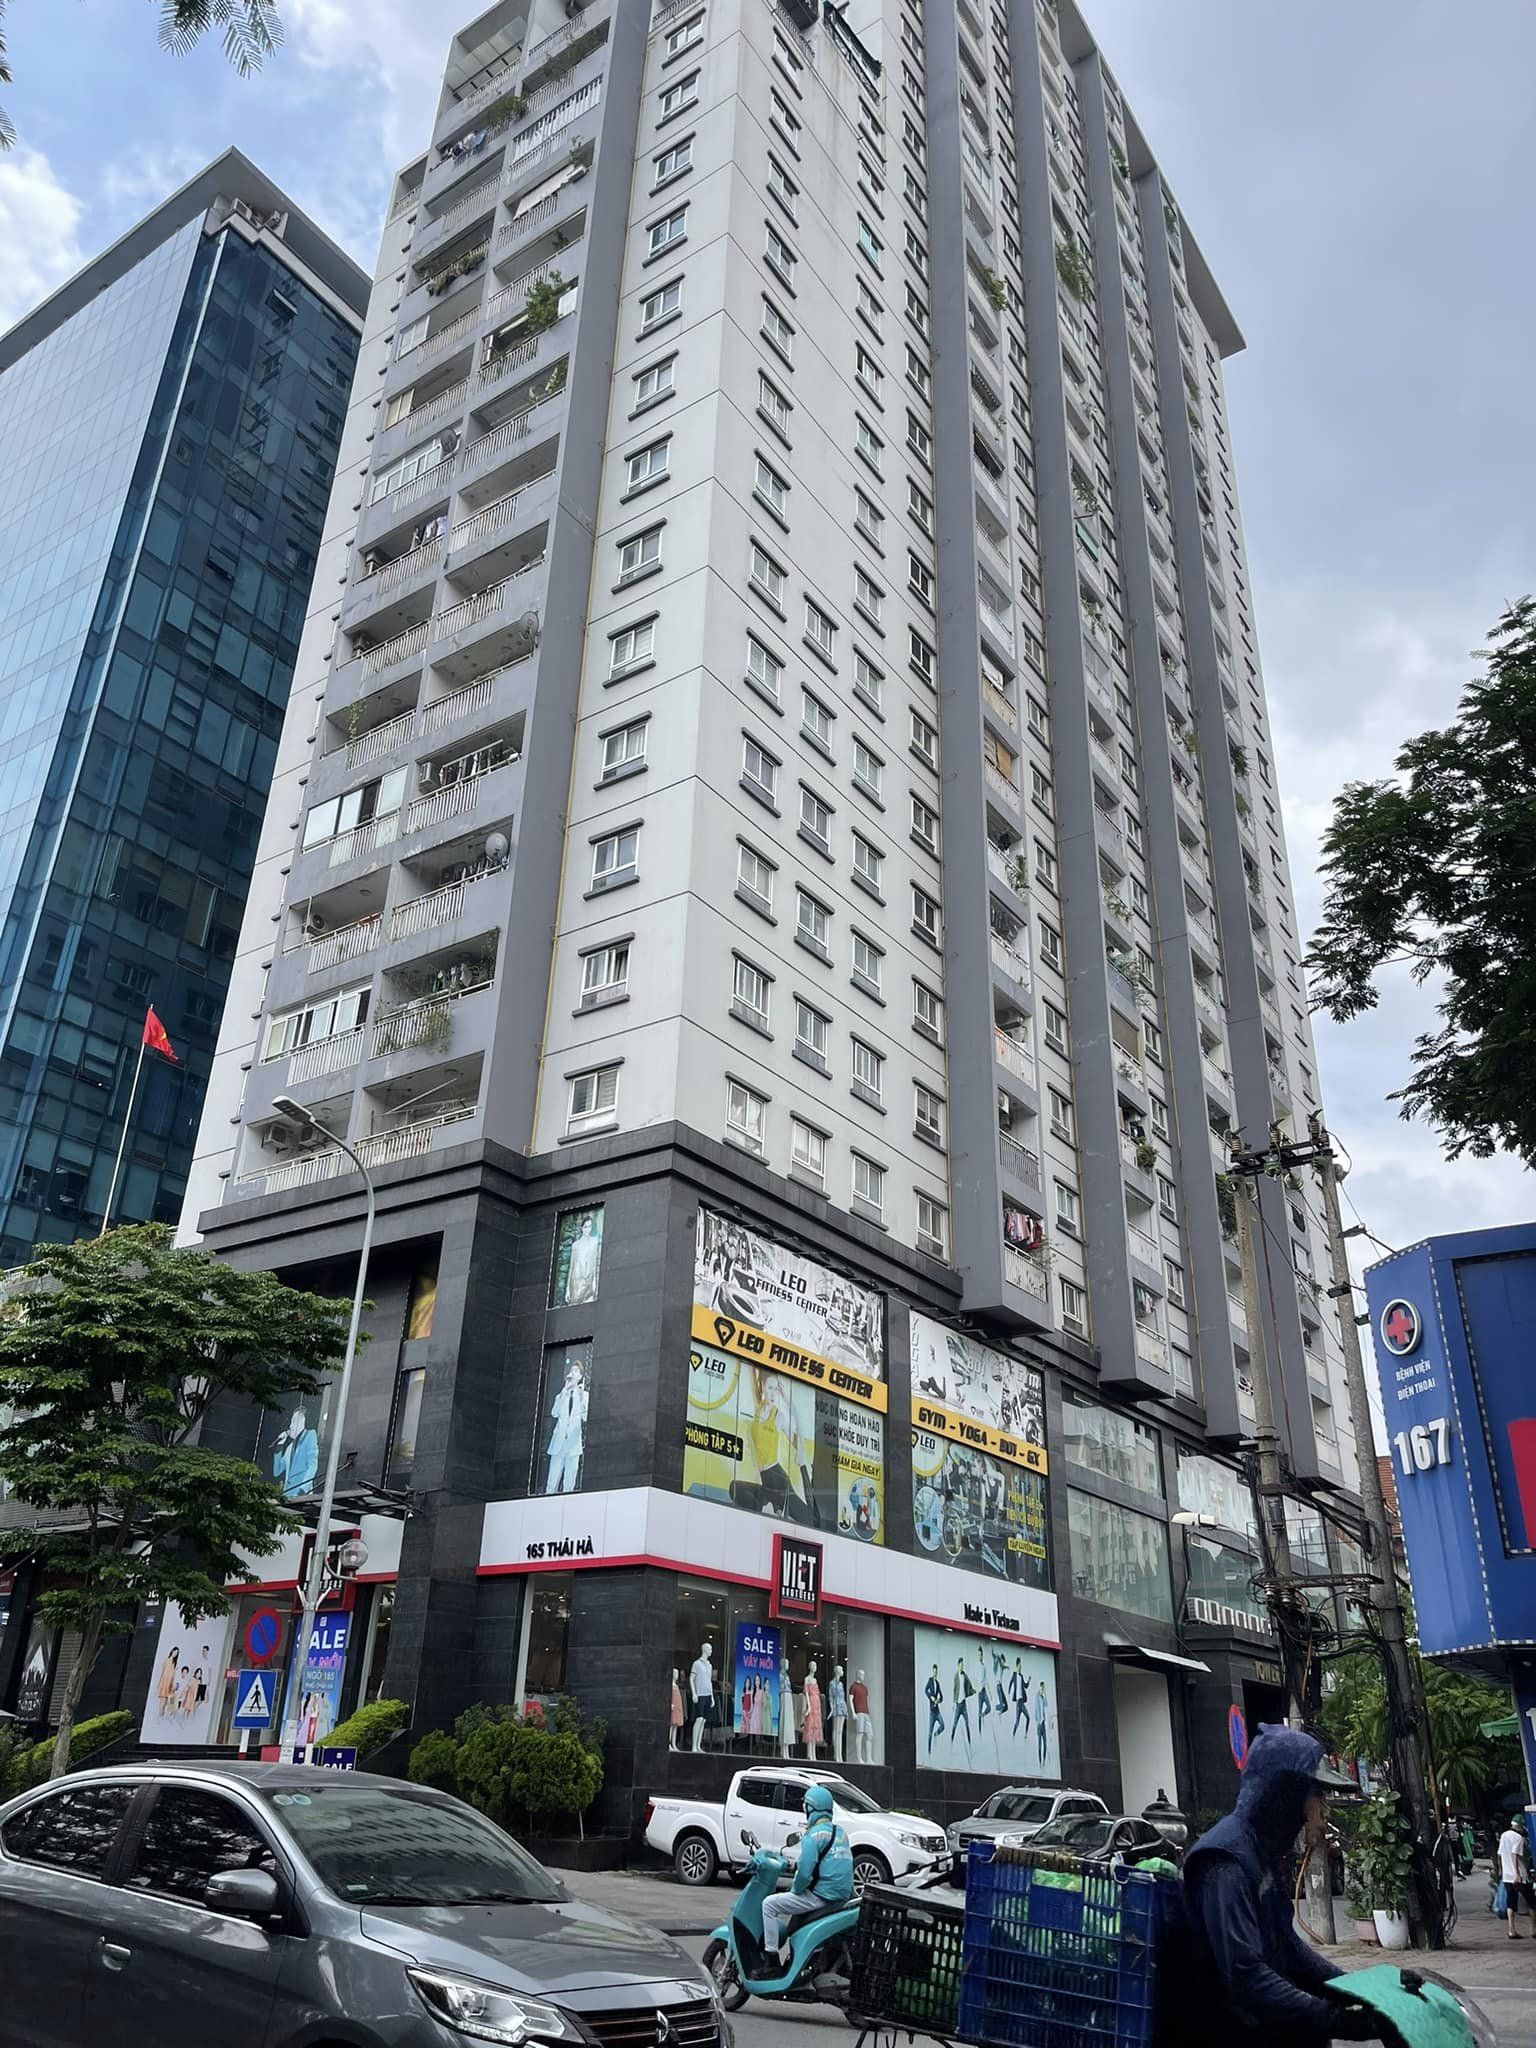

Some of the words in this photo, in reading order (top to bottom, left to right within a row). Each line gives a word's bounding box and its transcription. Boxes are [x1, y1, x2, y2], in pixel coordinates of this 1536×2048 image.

[780, 1270, 807, 1294] LEO
[756, 1278, 793, 1302] FITNESS
[796, 1296, 828, 1318] CENTER
[704, 1357, 726, 1374] LEO
[737, 1330, 765, 1354] LEO
[769, 1343, 825, 1379] FITNESS
[829, 1368, 873, 1399] CENTER
[919, 1407, 946, 1430] GYM
[959, 1422, 987, 1446] YOGA
[856, 1433, 869, 1449] DUY
[920, 1434, 936, 1450] LEO
[1393, 1417, 1451, 1475] 167
[851, 1459, 862, 1470] GIA
[526, 1543, 544, 1559] 165
[547, 1537, 574, 1557] THÁI
[576, 1535, 594, 1555] HÀ
[964, 1603, 983, 1623] Made
[984, 1607, 992, 1625] in
[992, 1609, 1020, 1632] Vietnam
[297, 1629, 346, 1650] ALE
[744, 1636, 774, 1654] SALE
